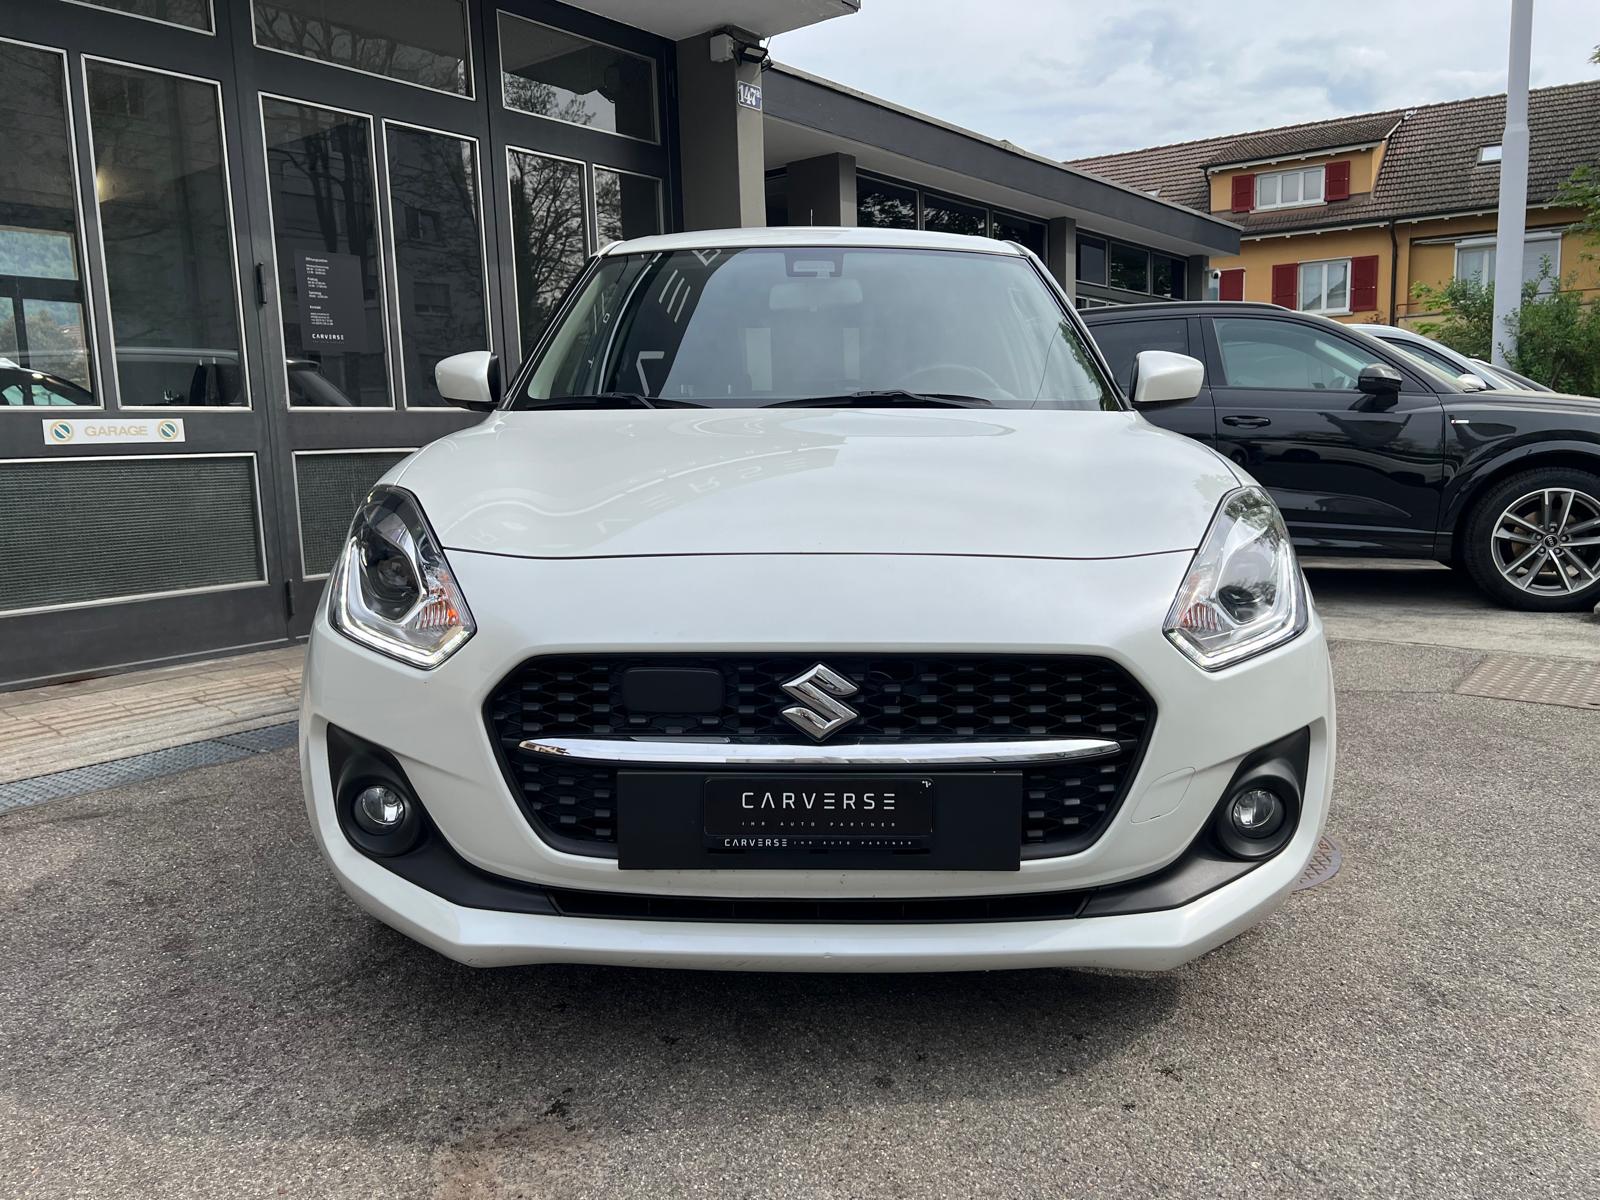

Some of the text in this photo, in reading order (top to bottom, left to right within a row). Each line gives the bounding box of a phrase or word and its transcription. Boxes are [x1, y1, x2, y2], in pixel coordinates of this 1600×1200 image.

[311, 333, 345, 341] CARVERSE
[84, 425, 149, 437] GARAGE
[741, 791, 896, 810] CARVERSE
[779, 820, 816, 828] AUTO
[724, 838, 788, 847] CARVERSE
